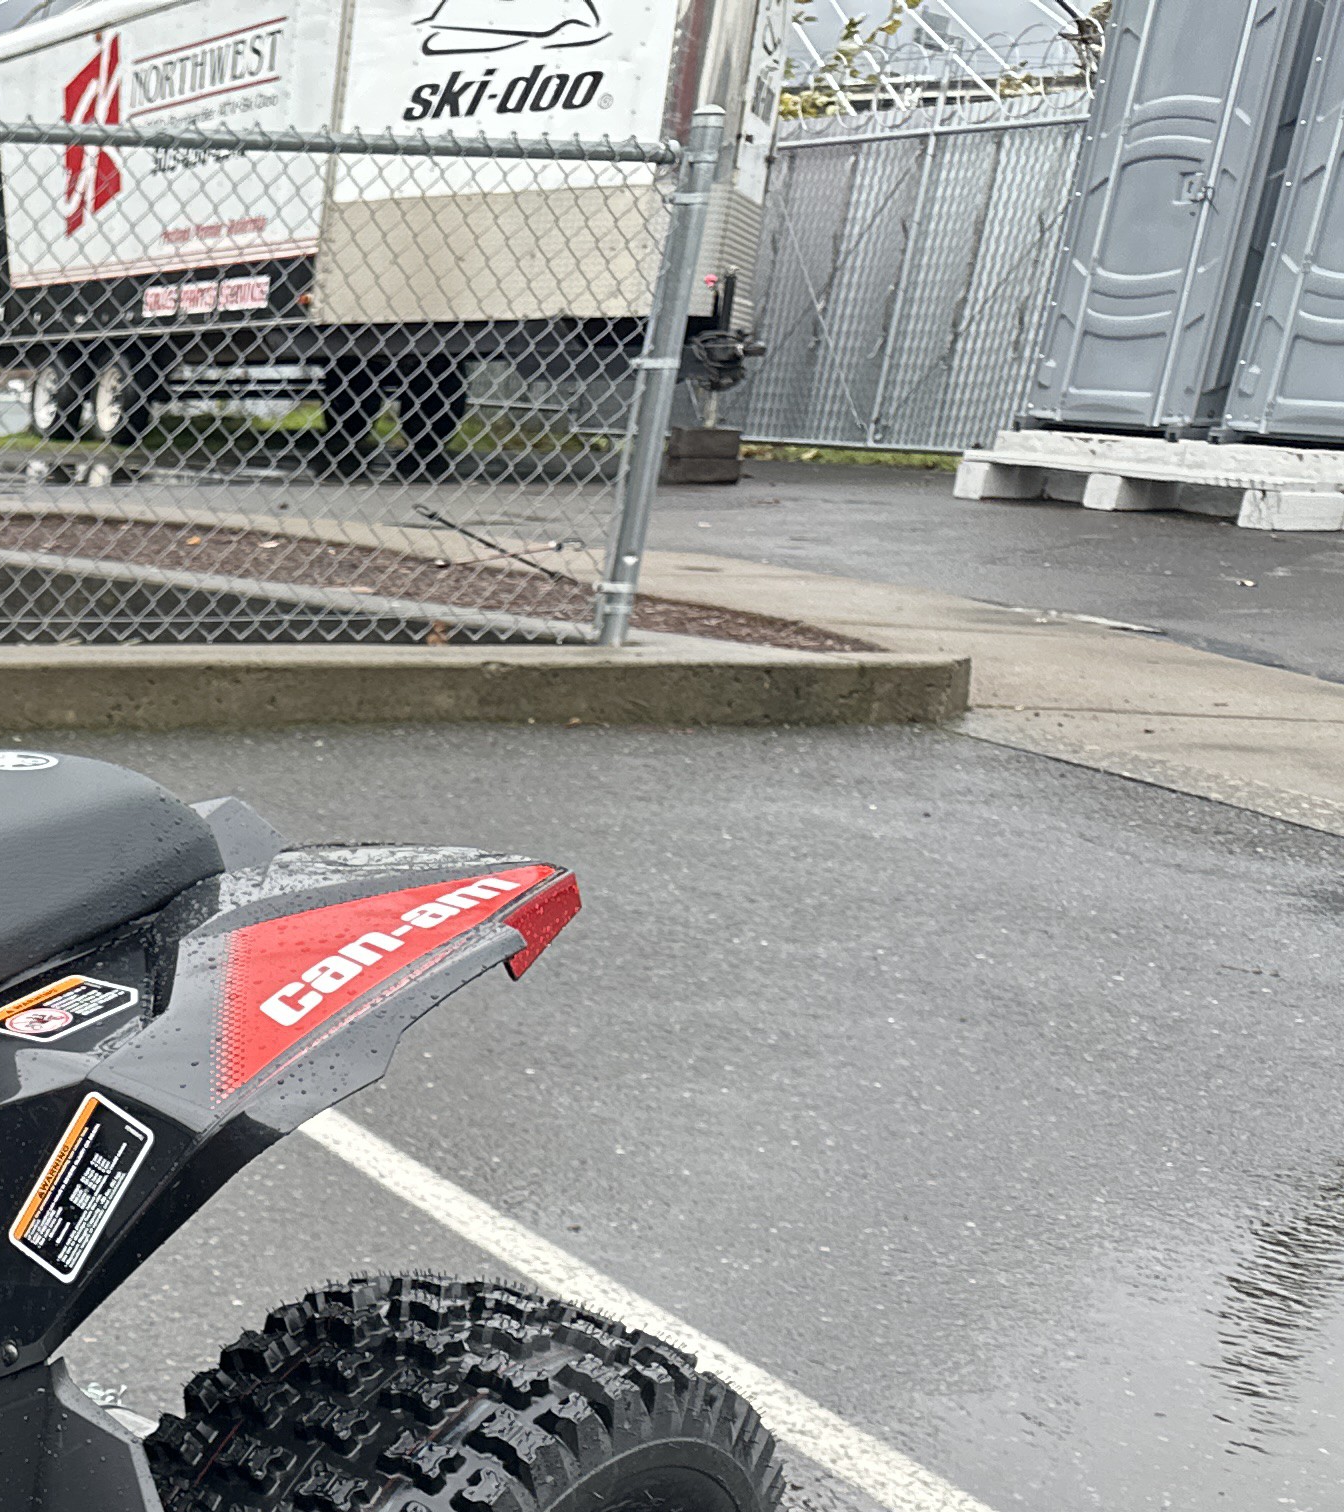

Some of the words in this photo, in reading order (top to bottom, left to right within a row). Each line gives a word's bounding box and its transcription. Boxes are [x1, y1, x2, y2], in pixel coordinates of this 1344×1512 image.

[130, 29, 284, 108] NORTHWEST
[403, 64, 604, 121] ski-doo
[259, 877, 521, 1027] can-am
[39, 1146, 69, 1192] WARNING
